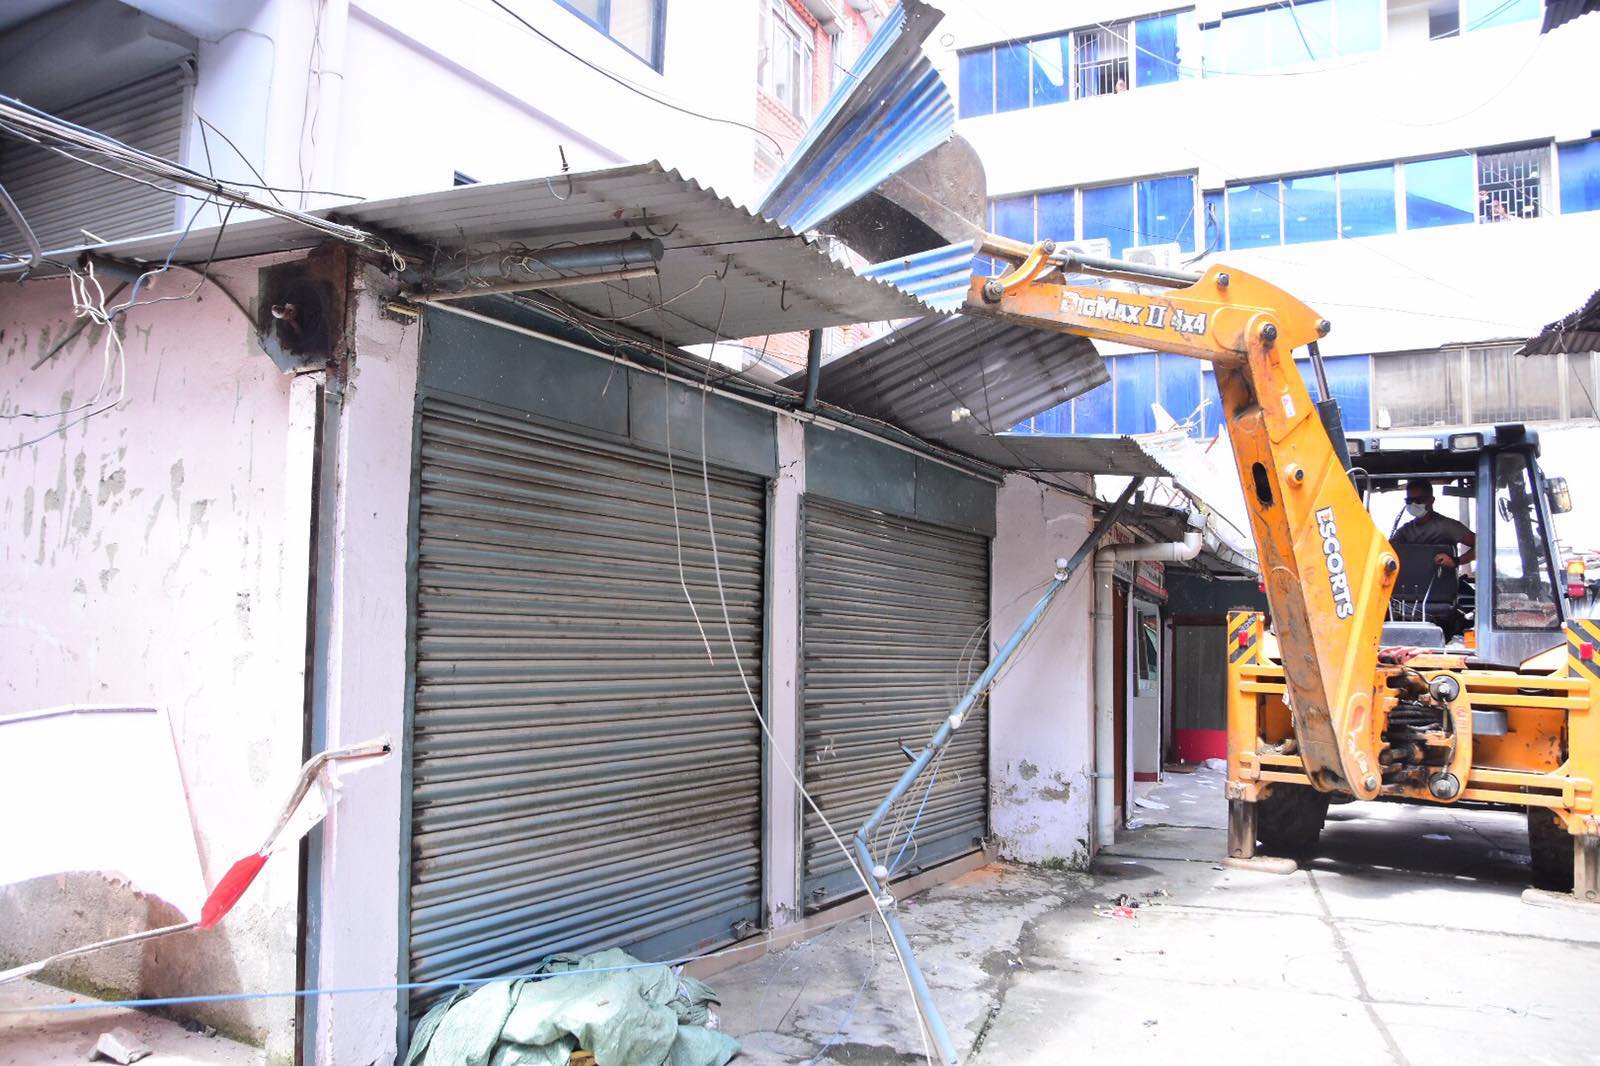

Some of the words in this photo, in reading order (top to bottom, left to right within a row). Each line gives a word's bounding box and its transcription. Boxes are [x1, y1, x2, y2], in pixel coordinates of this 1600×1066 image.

[1144, 303, 1168, 329] II
[1170, 309, 1208, 335] 4x4
[1315, 506, 1354, 620] ESCORTS
